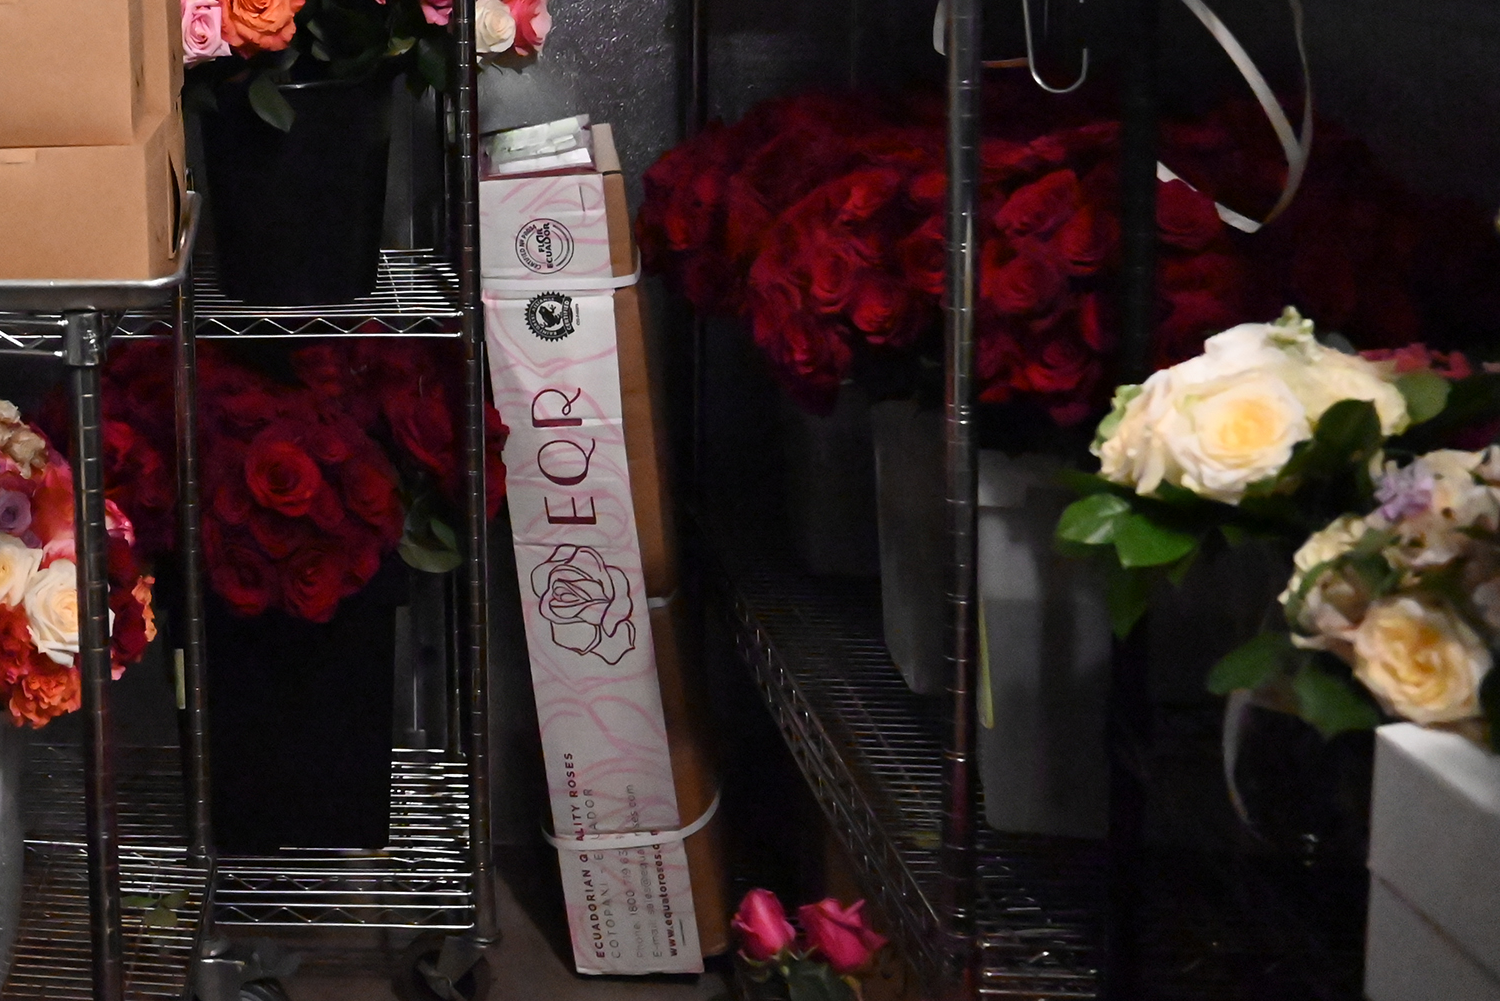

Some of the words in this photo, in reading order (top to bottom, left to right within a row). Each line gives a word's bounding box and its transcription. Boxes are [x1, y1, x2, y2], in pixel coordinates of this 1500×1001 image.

[543, 222, 554, 268] ECUADOR
[563, 300, 572, 331] CERTIFIED
[531, 387, 597, 525] EQR
[564, 752, 578, 798] ROSES
[571, 804, 588, 863] QALITY
[583, 788, 604, 860] EUADOR
[579, 869, 605, 958] ECUADORIAN
[626, 890, 638, 916] 1800
[651, 830, 678, 956] www.equatoroses.cm
